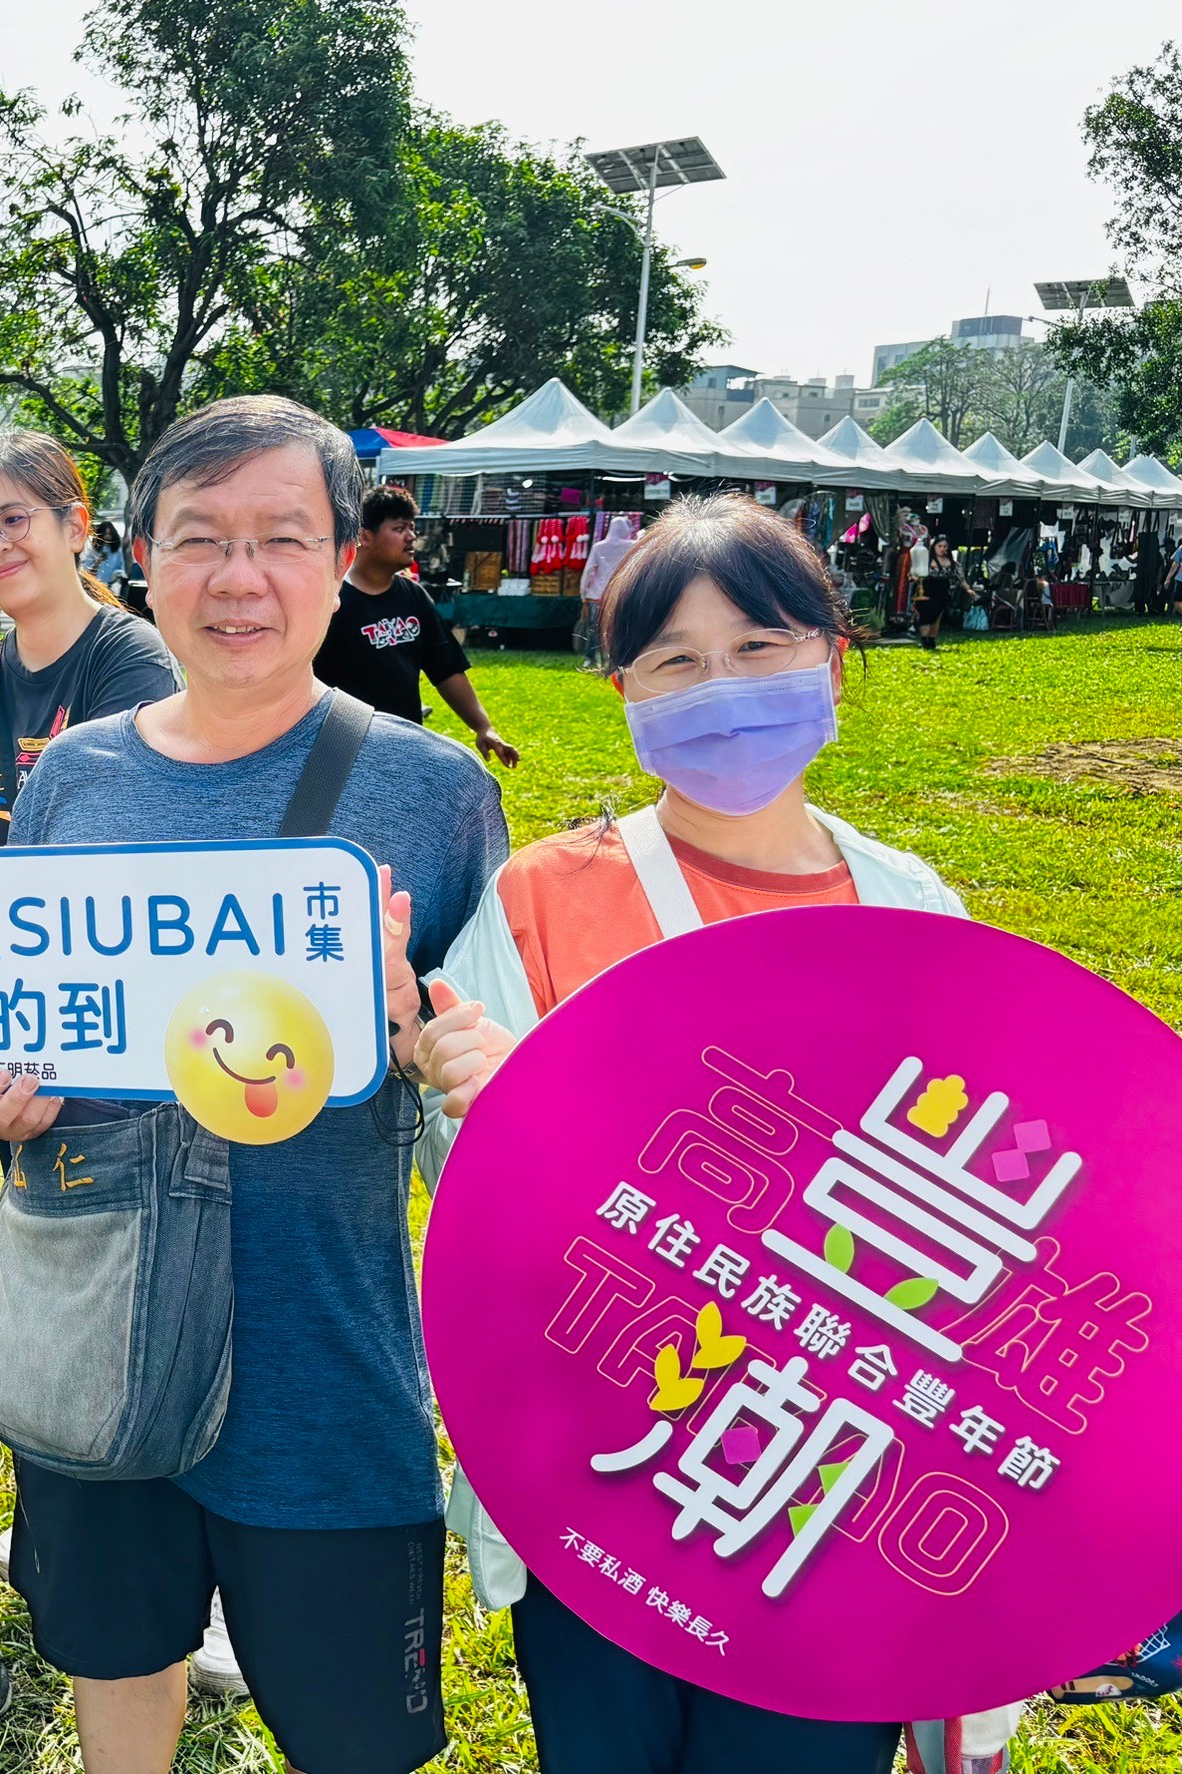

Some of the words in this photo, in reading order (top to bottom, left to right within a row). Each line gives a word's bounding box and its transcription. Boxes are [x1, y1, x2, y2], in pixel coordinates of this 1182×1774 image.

[302, 880, 346, 963] 市集
[595, 1180, 1061, 1491] 原住民族聯合豐年節
[559, 1526, 647, 1596] 不要私酒
[645, 1586, 730, 1656] 快樂長久
